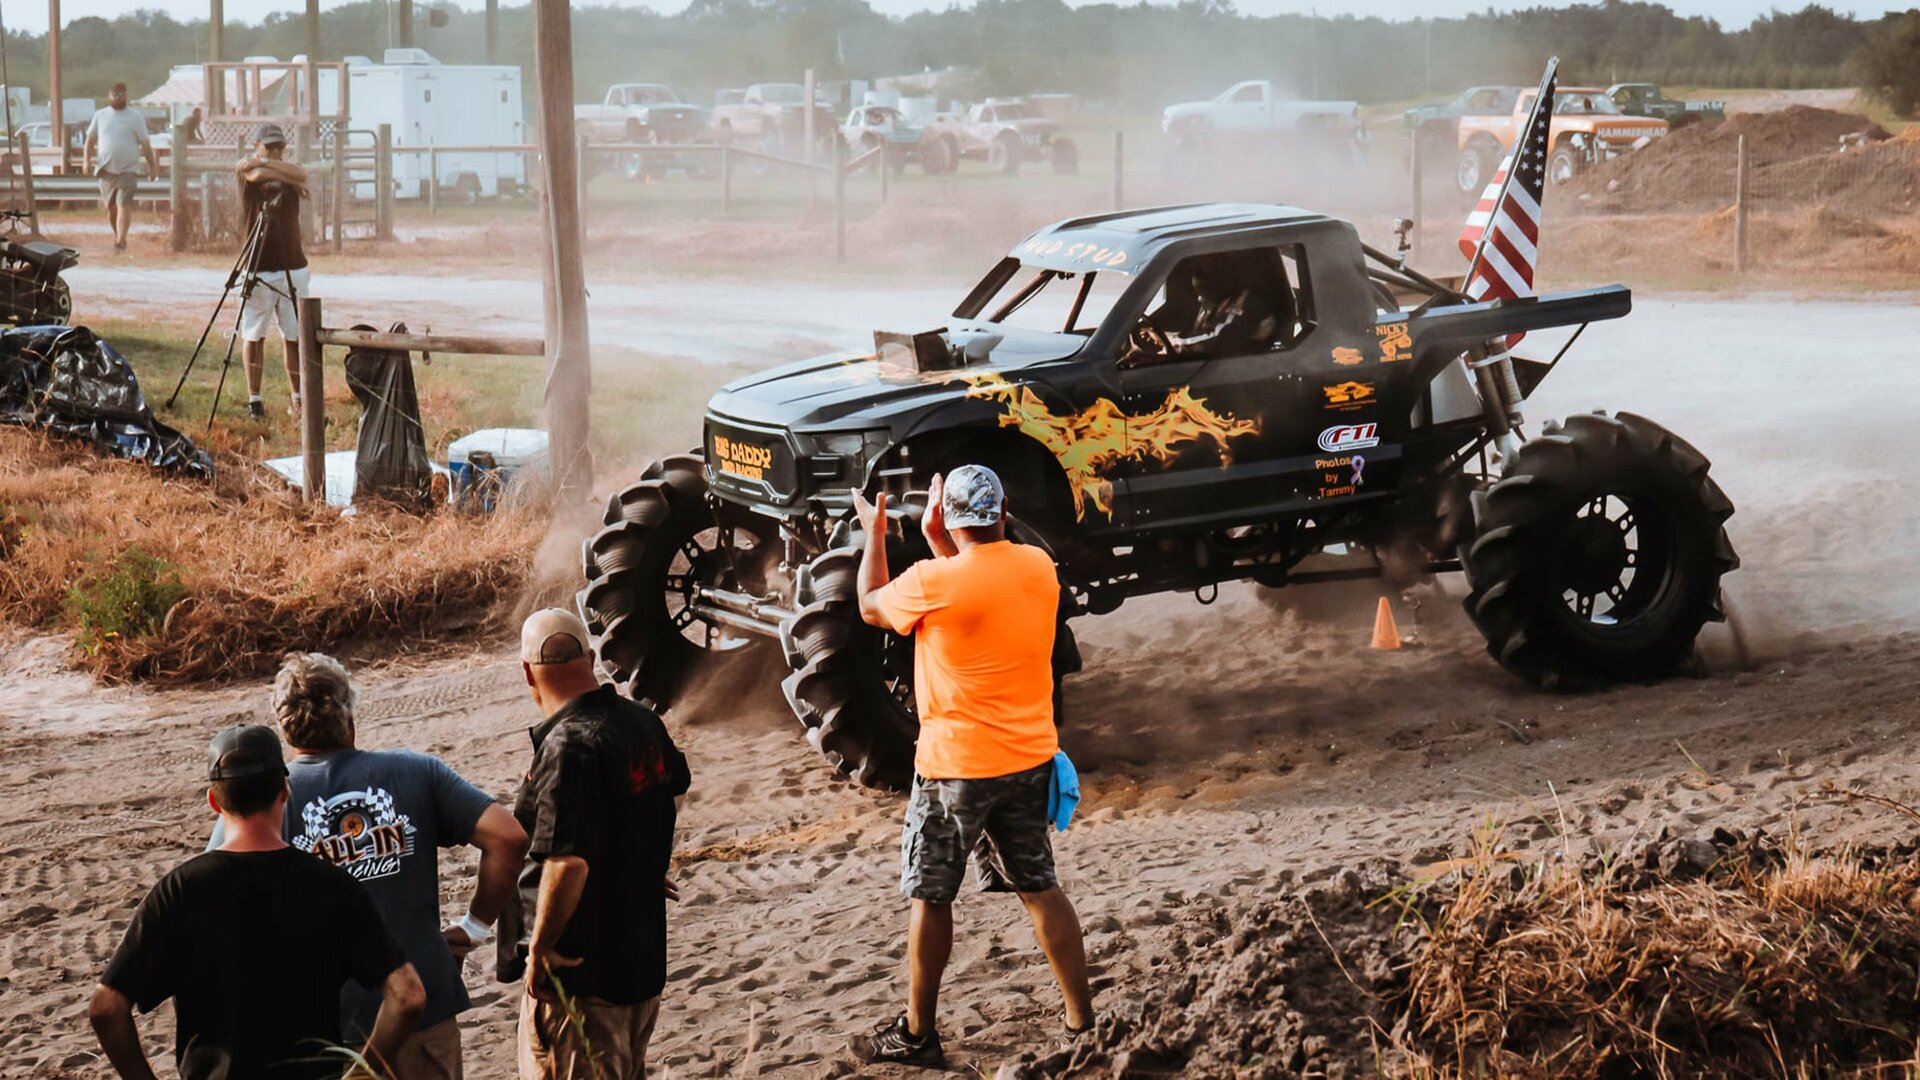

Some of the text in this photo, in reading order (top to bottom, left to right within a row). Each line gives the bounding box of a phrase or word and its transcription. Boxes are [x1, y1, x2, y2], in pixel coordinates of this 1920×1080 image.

[1597, 127, 1668, 137] HAMMERHEAD
[1064, 243, 1127, 266] STUD
[1332, 424, 1375, 443] FTI
[731, 442, 772, 469] DADDY
[1315, 457, 1352, 469] Photos
[1325, 473, 1339, 484] by
[1319, 485, 1356, 498] Tammy
